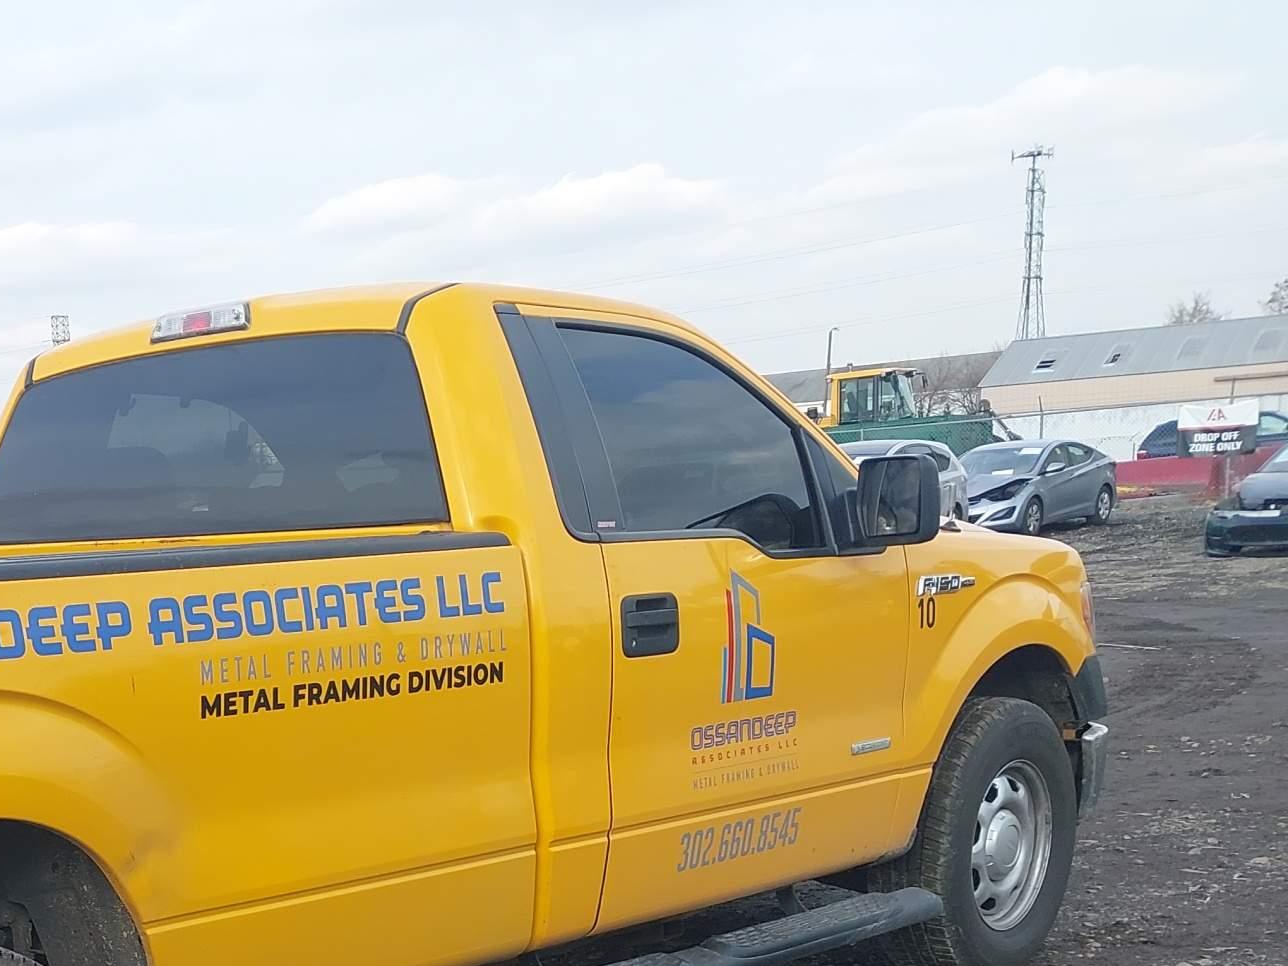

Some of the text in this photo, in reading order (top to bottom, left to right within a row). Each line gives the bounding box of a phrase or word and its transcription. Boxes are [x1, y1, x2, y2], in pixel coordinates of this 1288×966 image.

[1189, 441, 1243, 453] ZONE ONLY
[1193, 431, 1240, 443] DROP OFF
[148, 577, 425, 645] ASSOCIATES
[436, 572, 505, 618] LLC
[918, 597, 935, 629] 10
[200, 628, 507, 685] METAL FRAMING & DRYWALL
[200, 662, 503, 720] METAL FRAMING DIVISION
[691, 711, 797, 751] OSSANDEEP
[692, 738, 798, 765] ASSOCIATES LLC
[693, 778, 718, 790] METAL
[721, 767, 755, 784] FRAMING
[677, 807, 802, 872] 302.660.8545
